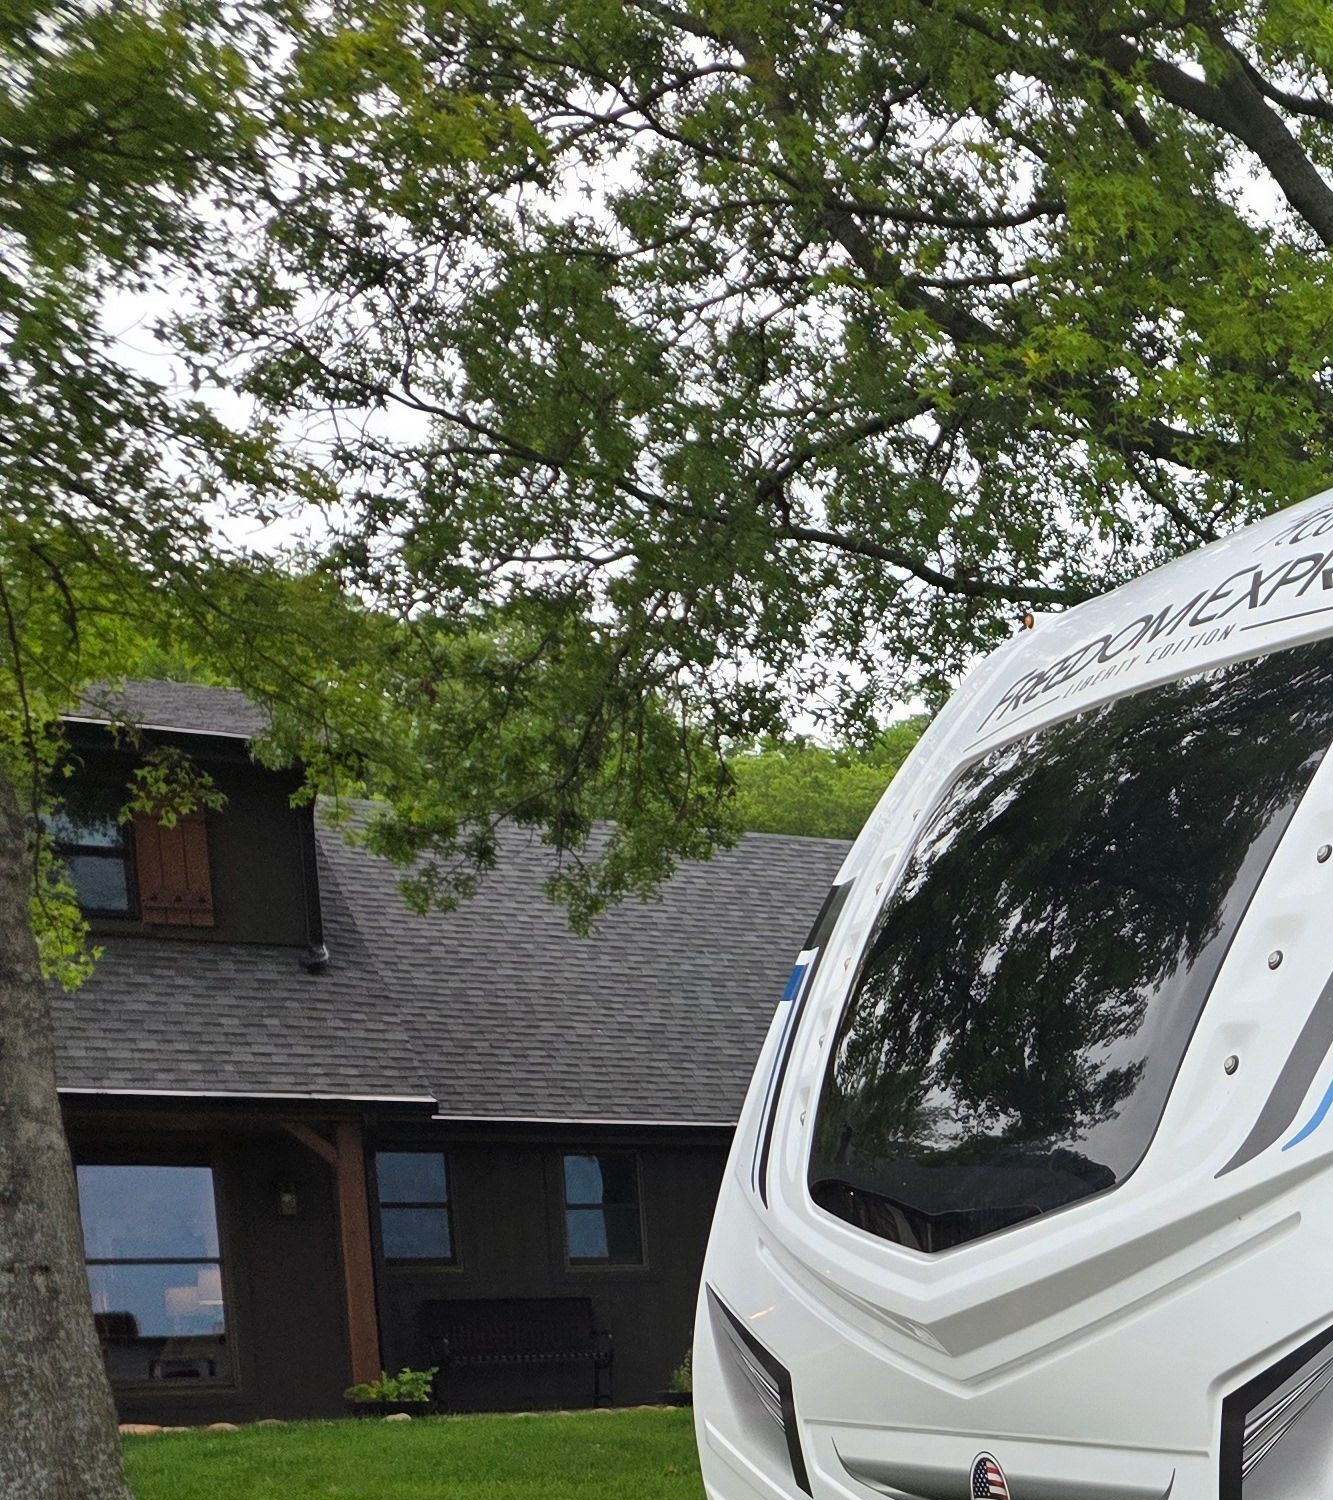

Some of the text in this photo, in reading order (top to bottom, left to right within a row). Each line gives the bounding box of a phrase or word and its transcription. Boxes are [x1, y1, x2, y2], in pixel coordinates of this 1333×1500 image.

[976, 589, 1209, 733] FREEDOM
[1063, 623, 1236, 699] LIBERTY EDITION
